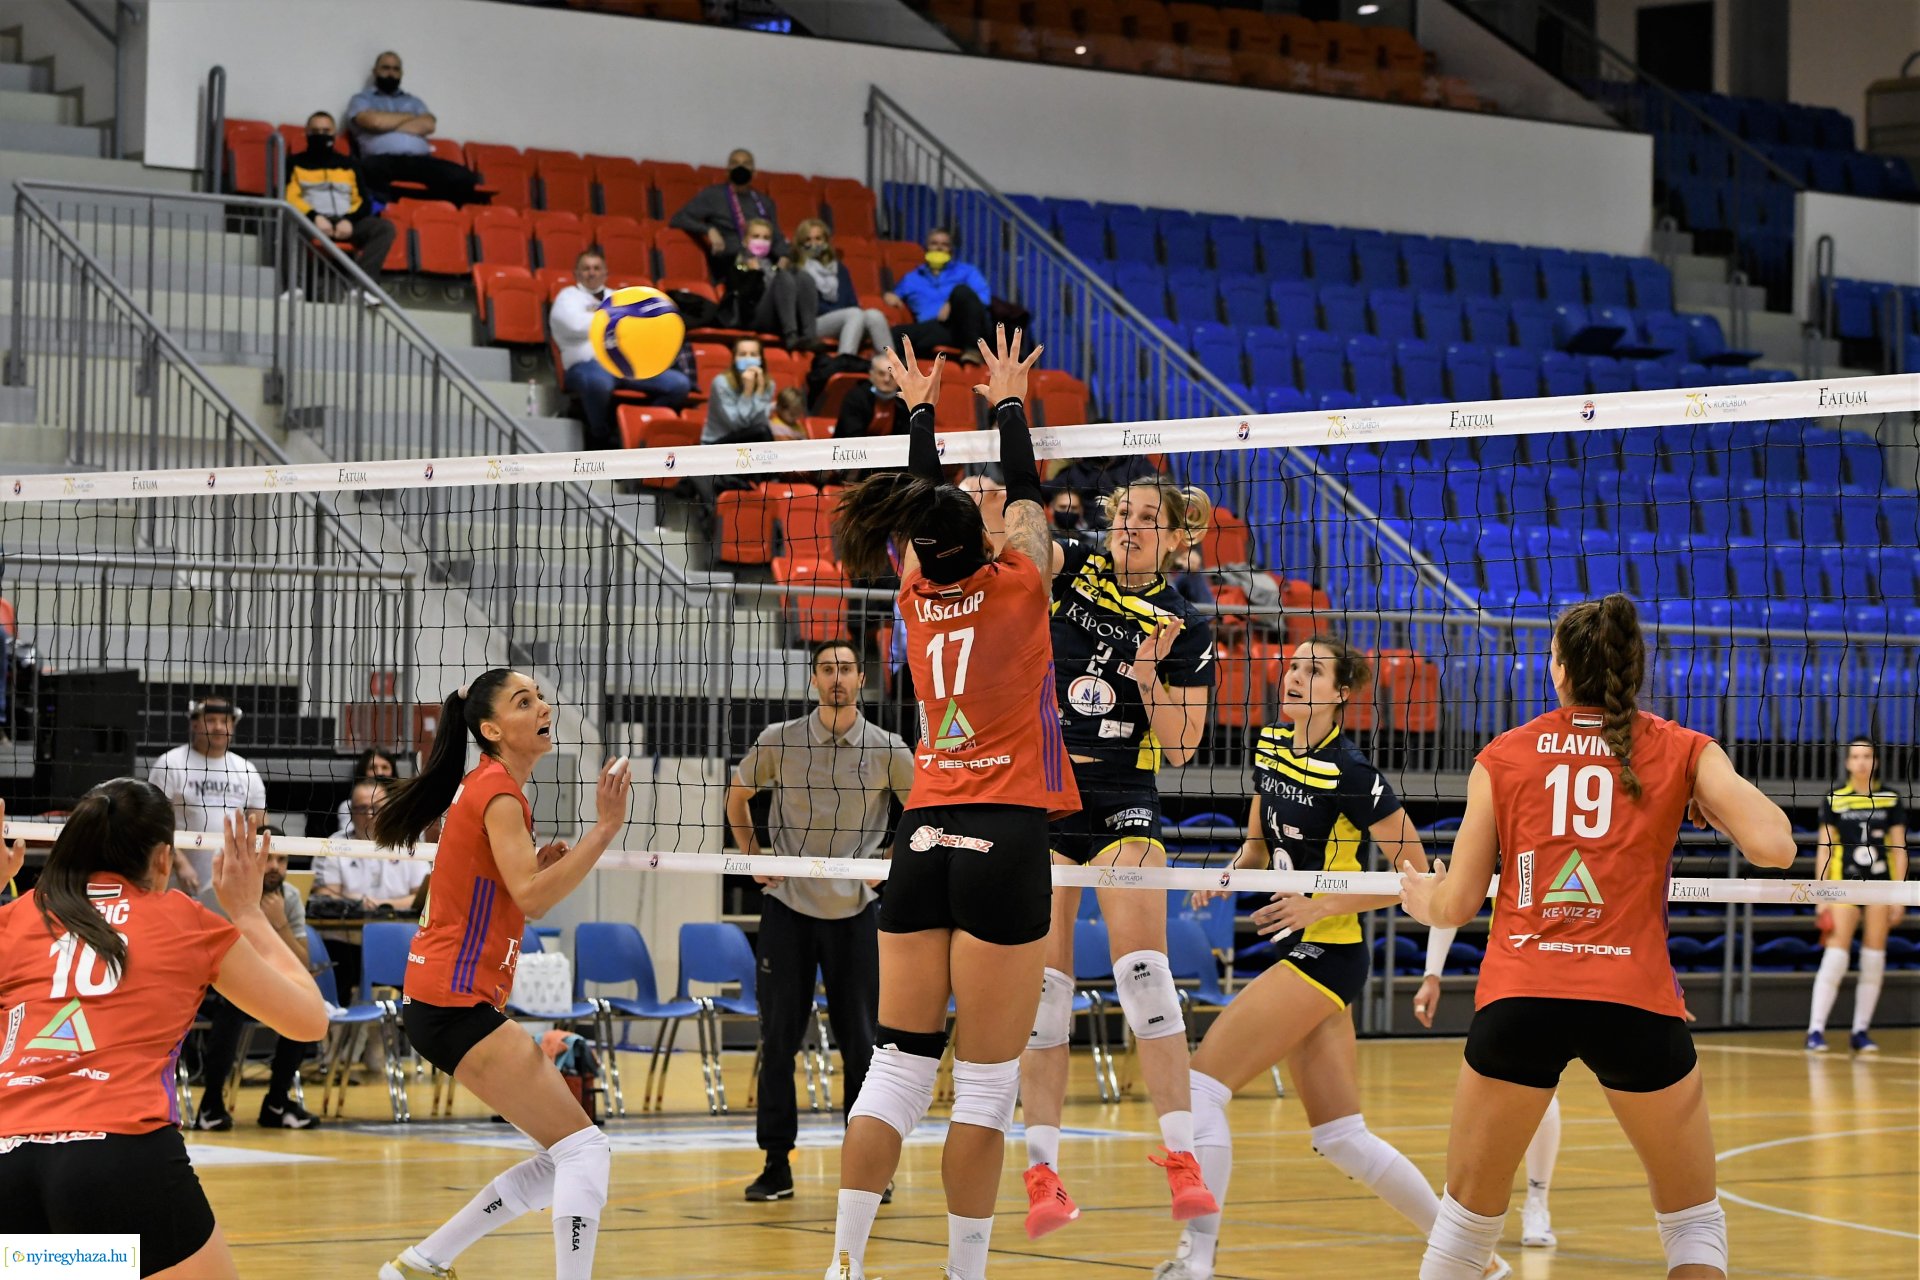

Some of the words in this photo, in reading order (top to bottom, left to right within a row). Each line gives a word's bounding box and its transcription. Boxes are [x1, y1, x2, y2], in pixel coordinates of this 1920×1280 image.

[1818, 387, 1868, 406] FATUM
[1449, 410, 1494, 427] FATUM
[1122, 429, 1161, 445] FATUM
[832, 445, 867, 460] FATUM
[573, 457, 605, 473] FATUM
[132, 476, 158, 490] FATUM
[338, 468, 367, 483] FATUM
[926, 626, 975, 699] 17
[938, 755, 1010, 769] BESTRONG
[1545, 764, 1614, 839] 19
[724, 858, 751, 871] FATUM
[1314, 874, 1348, 889] FATUM
[1523, 854, 1532, 905] STRABAG
[1671, 882, 1710, 898] FATUM
[1542, 906, 1585, 919] KE-VIZ
[1587, 909, 1602, 919] 21
[1538, 942, 1631, 956] BESTRONG
